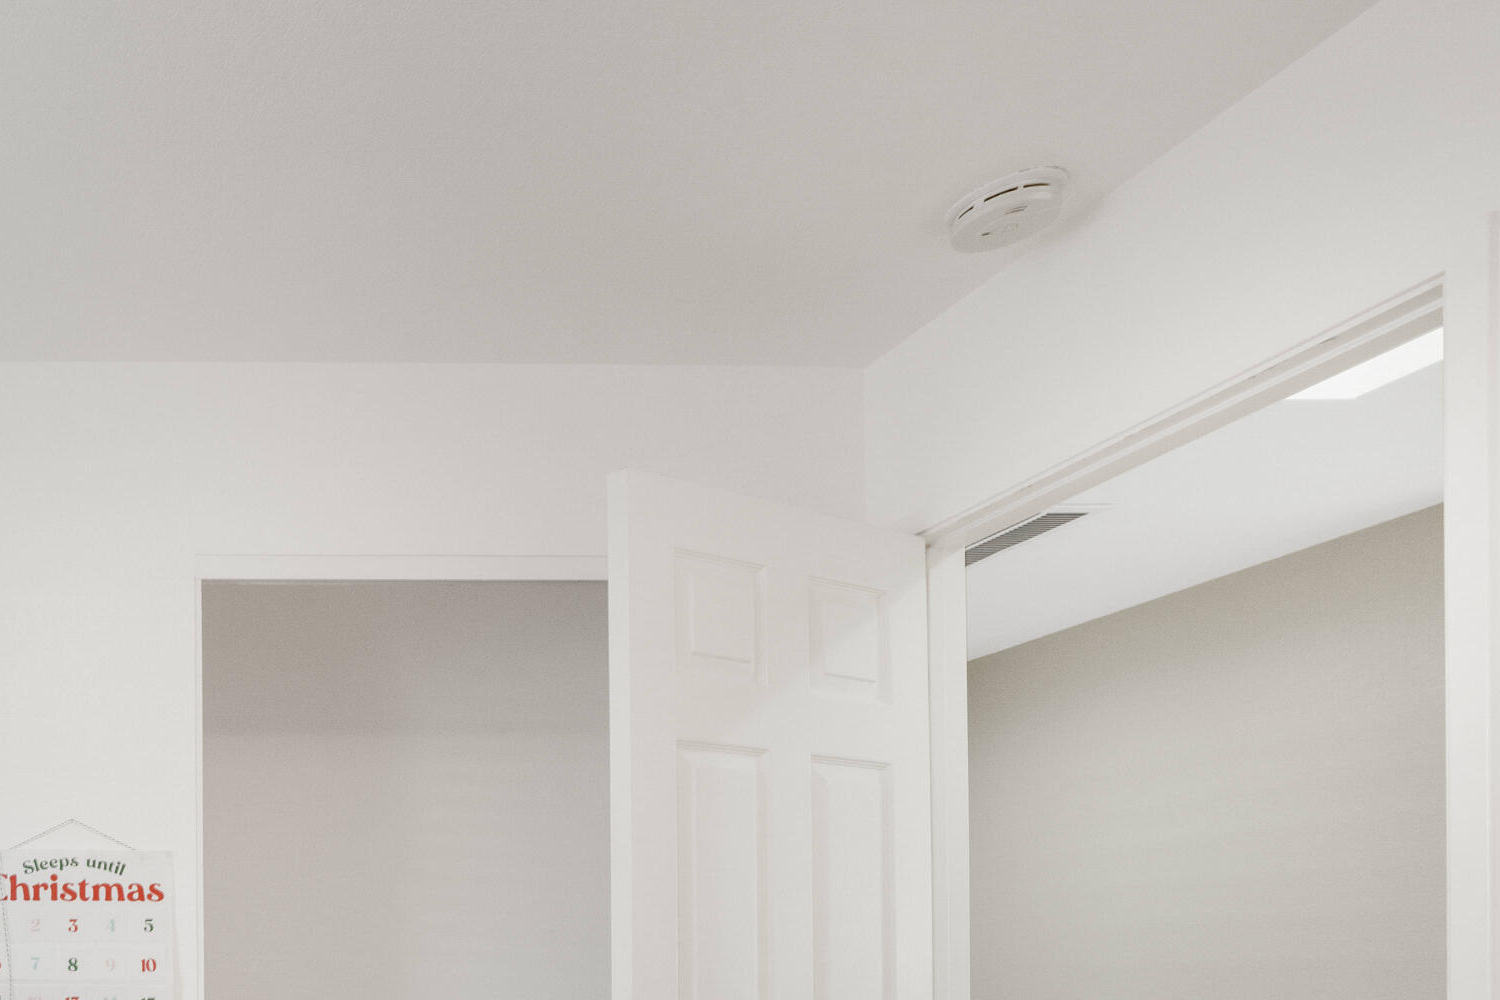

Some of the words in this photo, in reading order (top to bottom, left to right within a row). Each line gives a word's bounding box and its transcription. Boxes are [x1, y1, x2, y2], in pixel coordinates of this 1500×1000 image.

[22, 856, 79, 875] Sleeps
[86, 857, 126, 876] until
[30, 919, 41, 932] 2
[68, 918, 78, 933] 3
[107, 919, 116, 932] 4
[143, 919, 154, 933] 5
[30, 957, 41, 970] 7
[67, 957, 78, 972] 8
[106, 958, 116, 971] 9
[141, 958, 157, 973] 10
